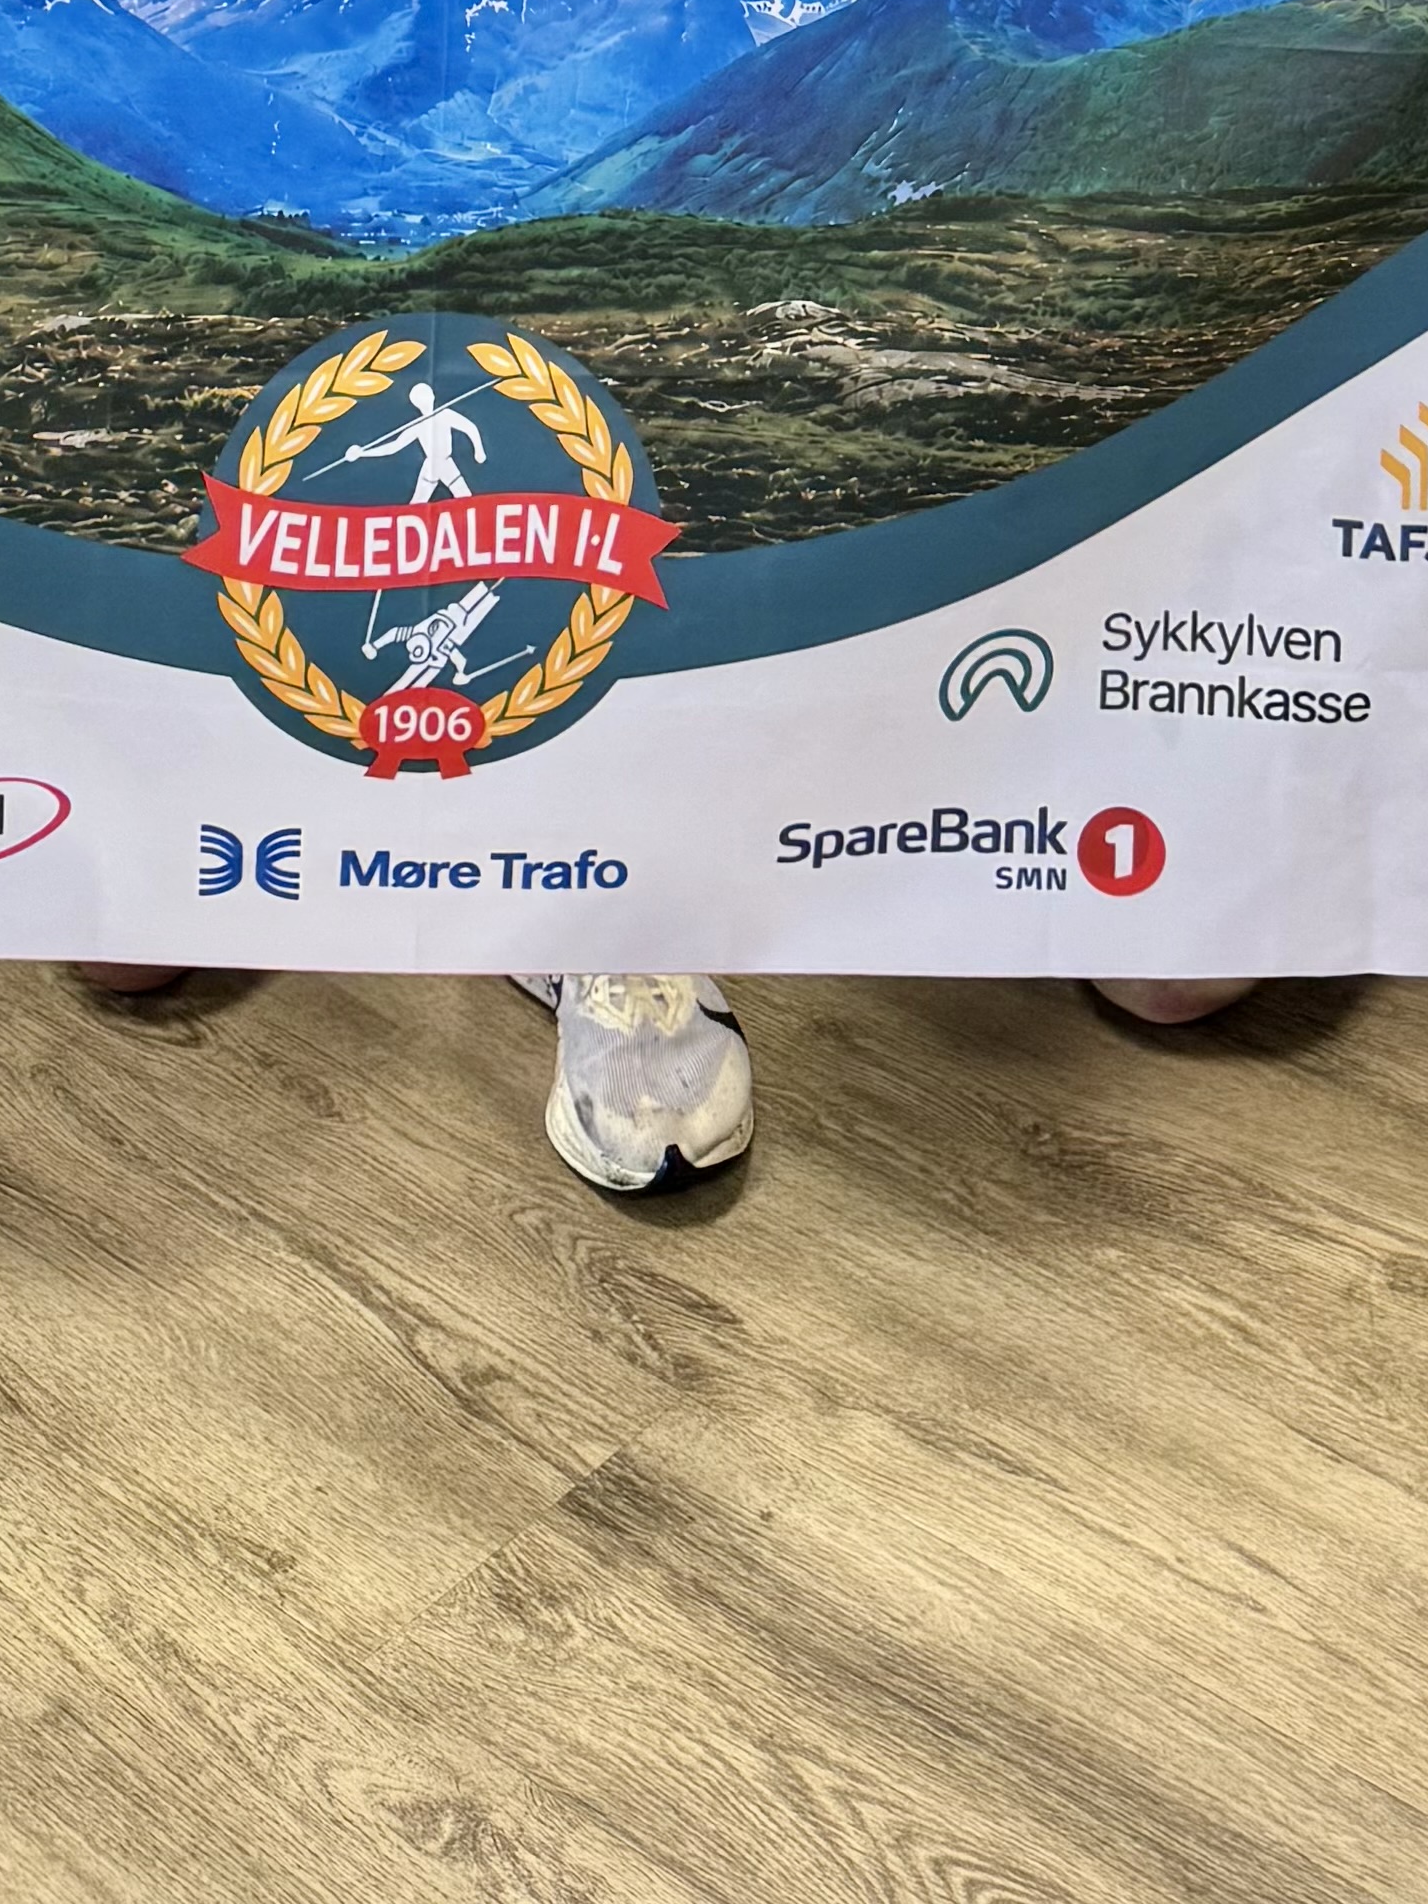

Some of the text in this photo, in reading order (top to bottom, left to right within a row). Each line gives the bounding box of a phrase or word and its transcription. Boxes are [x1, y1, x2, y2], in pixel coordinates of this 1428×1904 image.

[239, 503, 556, 577] VELLEDALEN
[1102, 611, 1342, 665] Sykkylven
[373, 705, 472, 743] 1906
[1100, 670, 1371, 724] Brannkasse
[339, 848, 628, 890] Møre Trafo
[776, 804, 1136, 880] SpareBank 1
[995, 866, 1067, 891] SMN
